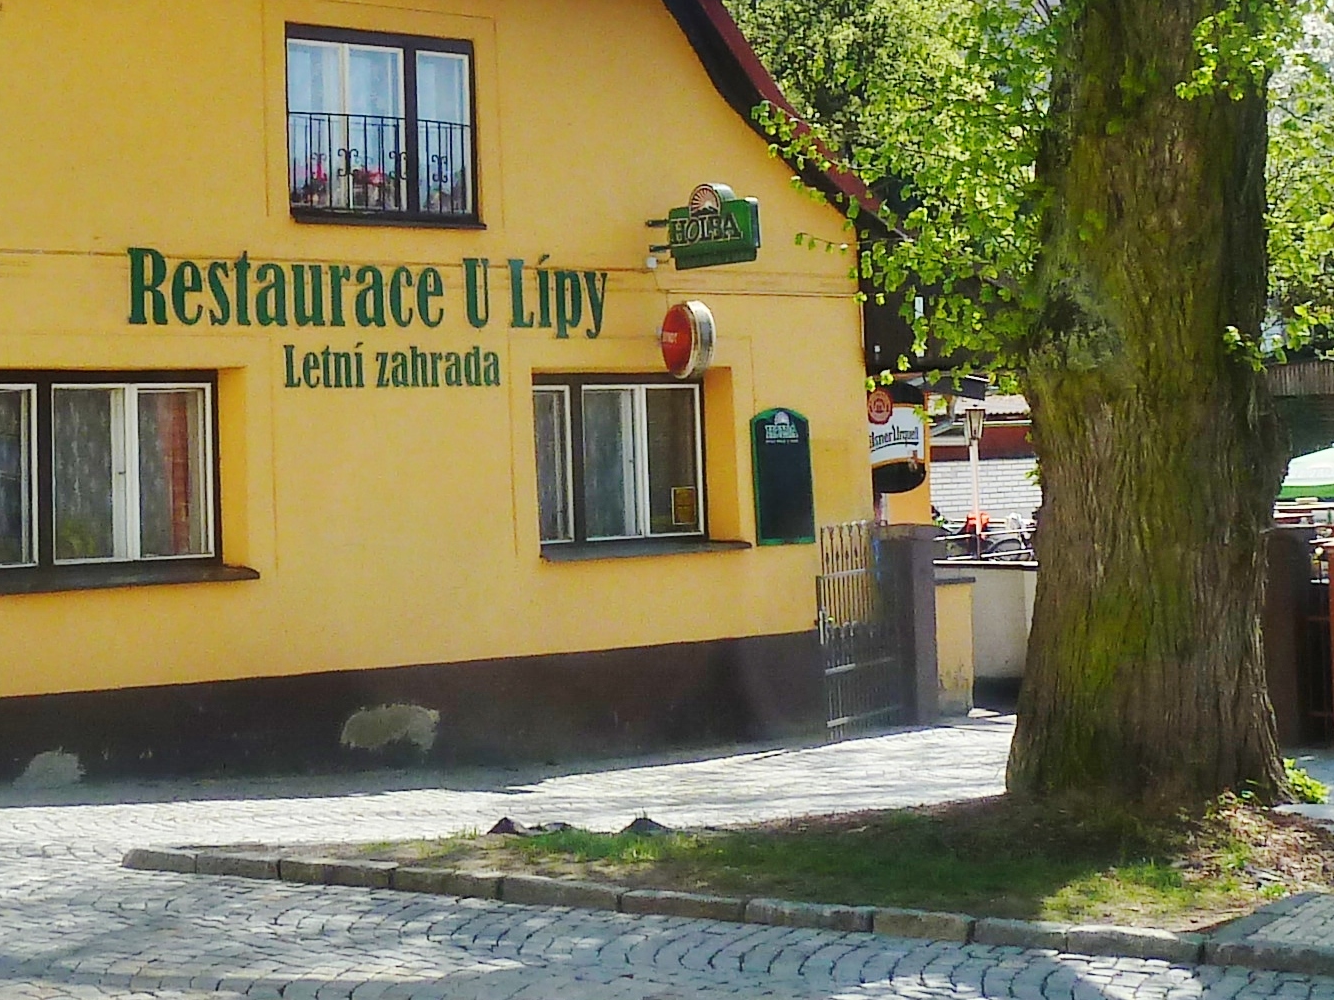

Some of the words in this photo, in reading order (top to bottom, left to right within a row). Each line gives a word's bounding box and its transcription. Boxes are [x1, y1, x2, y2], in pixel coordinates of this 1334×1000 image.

[670, 212, 743, 247] HOLBA
[128, 247, 444, 327] Restaurace
[463, 257, 490, 328] U
[507, 254, 608, 339] Lípy
[284, 342, 365, 389] Letní
[376, 345, 501, 389] zahrada
